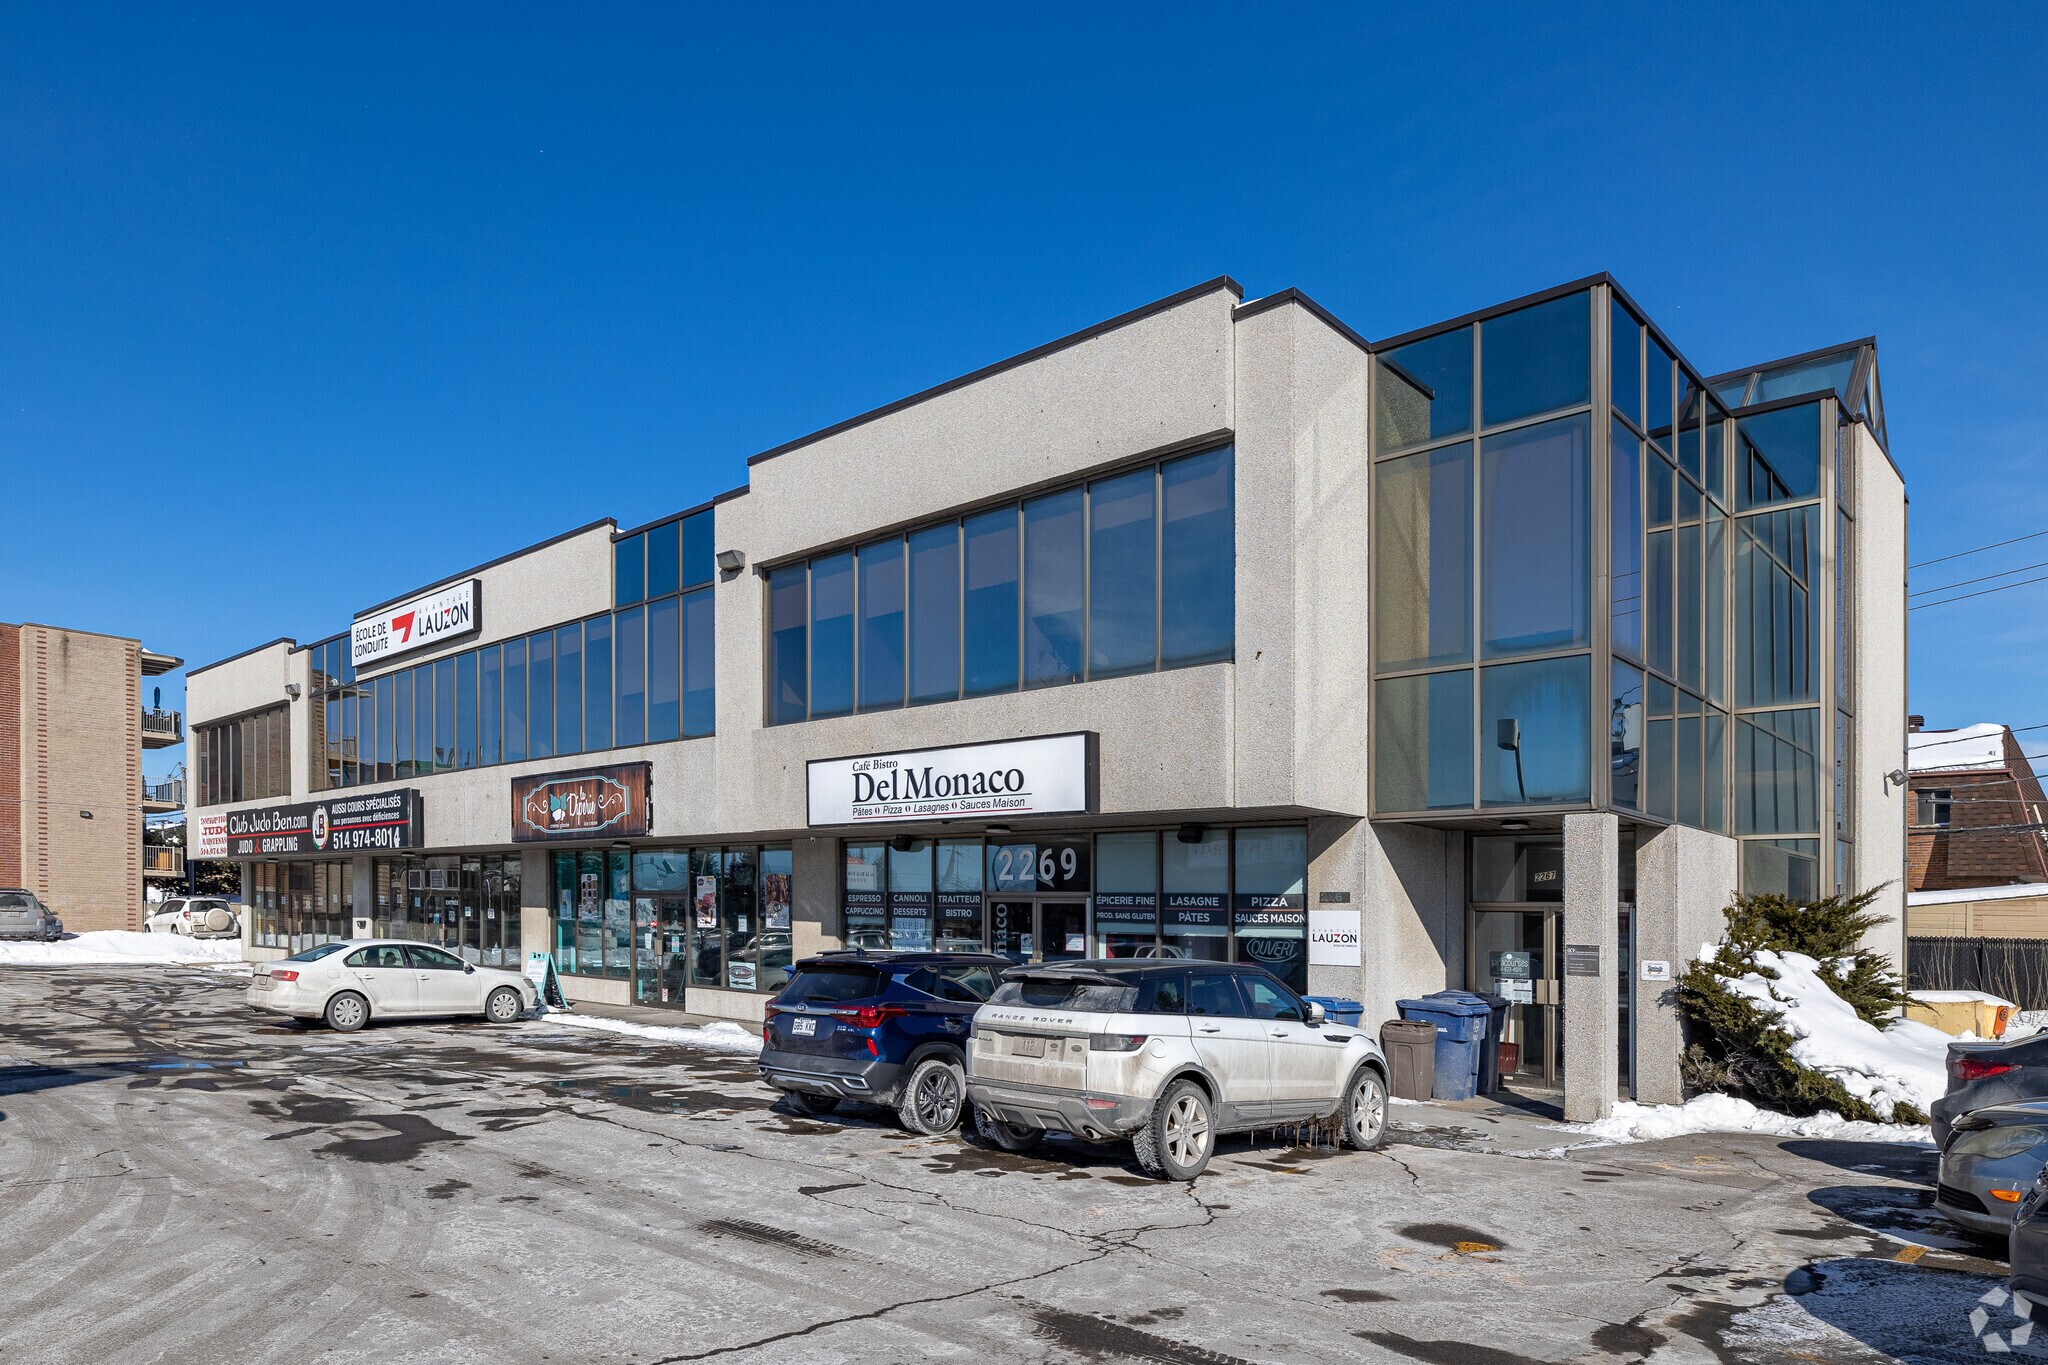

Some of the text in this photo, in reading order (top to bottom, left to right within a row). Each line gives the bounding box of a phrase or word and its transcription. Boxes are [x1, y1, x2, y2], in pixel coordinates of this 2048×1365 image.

[418, 590, 469, 613] AVANTAGE
[418, 601, 469, 637] LAUZON
[356, 622, 387, 642] ÉCOLE DE
[354, 637, 388, 657] CONDUITE
[852, 759, 898, 772] Café Bistro
[852, 766, 1025, 803] Del Monaco
[332, 794, 401, 815] AUSSI COURS SPÉCIALISÉS
[852, 797, 1025, 816] Pâtes Pizza Lasagnes Sauces Maison
[230, 811, 308, 834] Club Judo Ben.com
[341, 816, 361, 826] personnes
[373, 811, 399, 822] déficiences
[333, 826, 401, 849] 514 974-8014
[238, 837, 298, 854] JUDO & GRAPPLING
[998, 847, 1077, 881] 2269
[1535, 871, 1555, 881] 2267
[848, 894, 882, 902] ESPRESSO
[893, 894, 927, 903] CANNOLI
[938, 895, 981, 904] TRAITTEUR
[1096, 894, 1156, 905] ÉPICERIE FINE
[1170, 896, 1219, 906] LASAGNE
[1251, 897, 1288, 907] PIZZA
[845, 907, 884, 915] CAPPUCCINO
[893, 908, 927, 916] DESSERTS
[945, 909, 972, 918] BISTRO
[1096, 911, 1113, 919] PROD.
[1132, 912, 1156, 920] GLUTEN
[1178, 910, 1210, 922] PÂTES
[1235, 913, 1306, 924] SAUCES MAISON
[897, 921, 924, 930] SUPER
[1312, 933, 1357, 943] LAUZON
[1251, 940, 1298, 956] OUVERT
[992, 1013, 1073, 1024] RANGE ROVER
